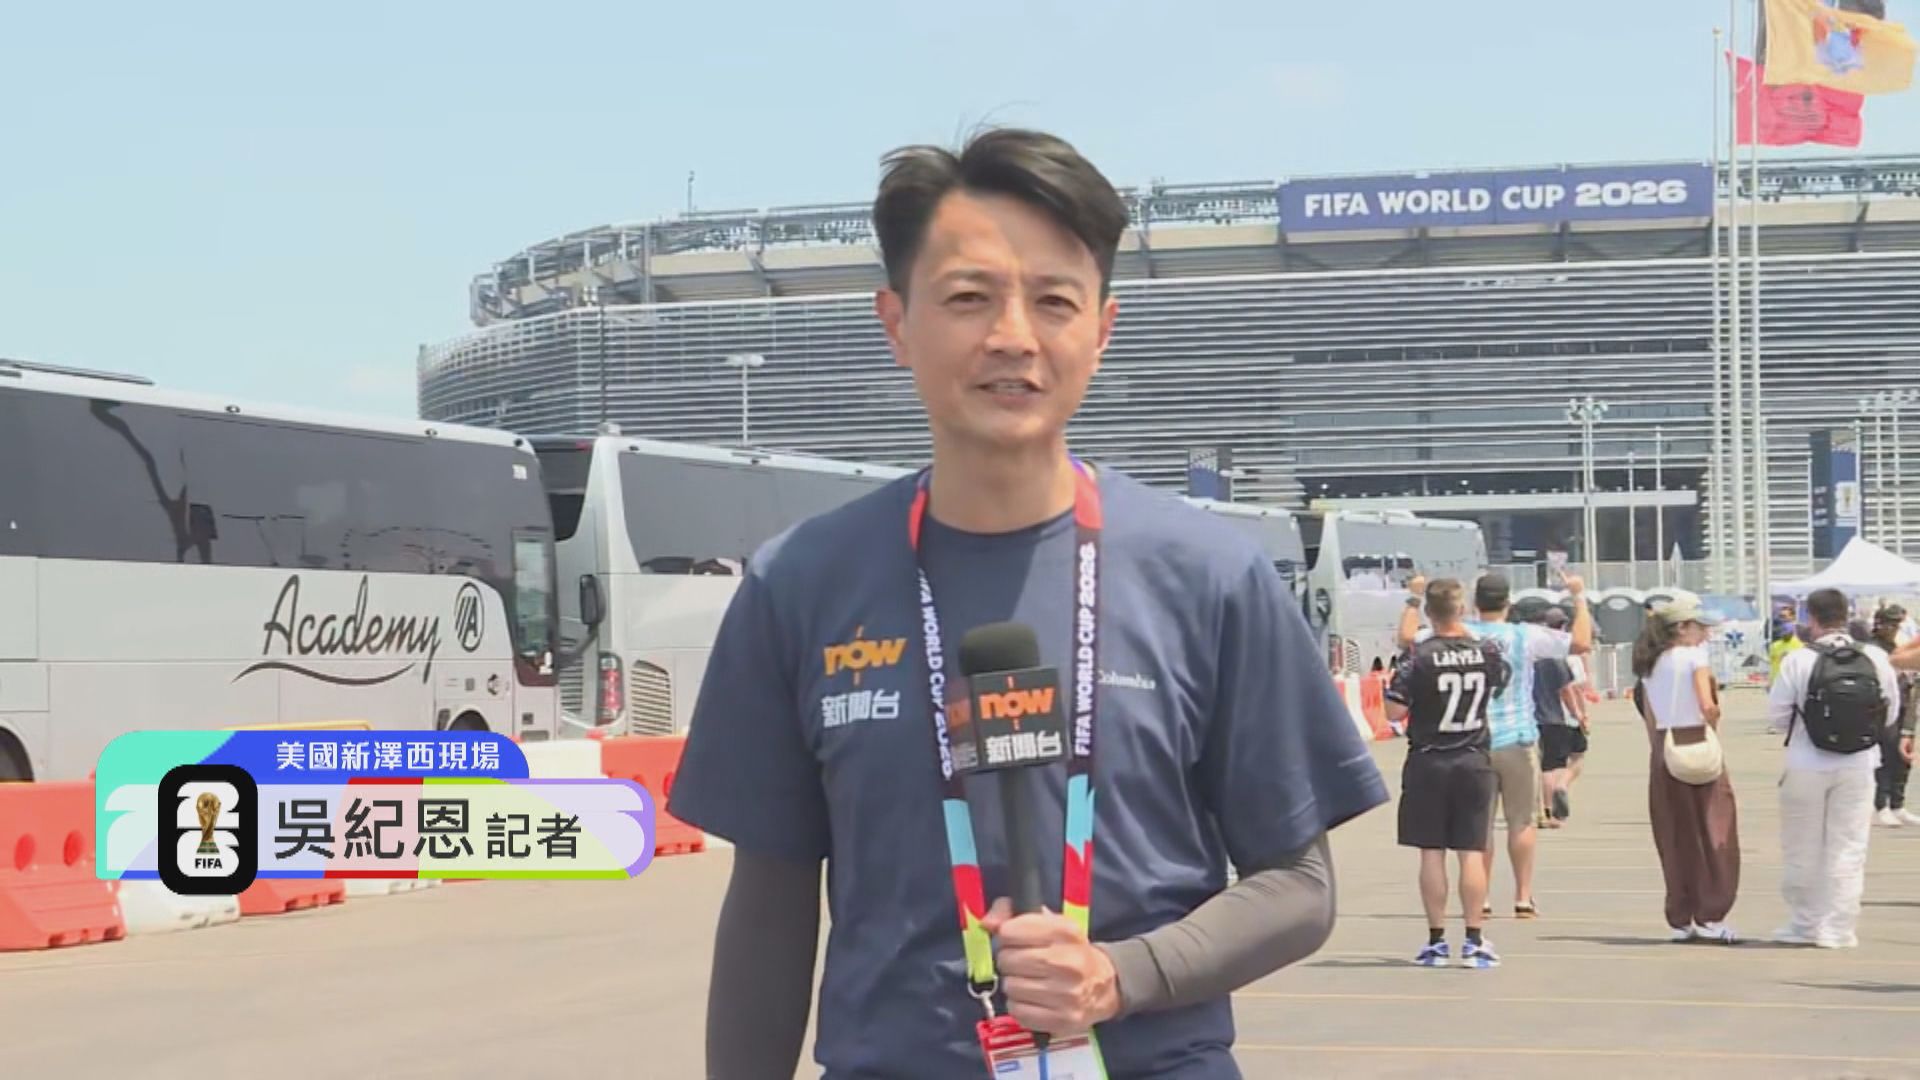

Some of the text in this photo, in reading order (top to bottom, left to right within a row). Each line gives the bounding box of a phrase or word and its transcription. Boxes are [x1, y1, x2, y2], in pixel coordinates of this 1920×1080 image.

[1304, 179, 1687, 218] FIFA WORLD CUP 2026
[262, 573, 442, 685] Academy
[922, 605, 944, 670] WORLD
[823, 638, 907, 676] now
[1074, 541, 1097, 757] FIFA WORLD CUP 2026
[928, 671, 946, 710] CUP
[978, 686, 1055, 720] now
[1438, 671, 1486, 732] 22
[985, 730, 1063, 764] 新聞台
